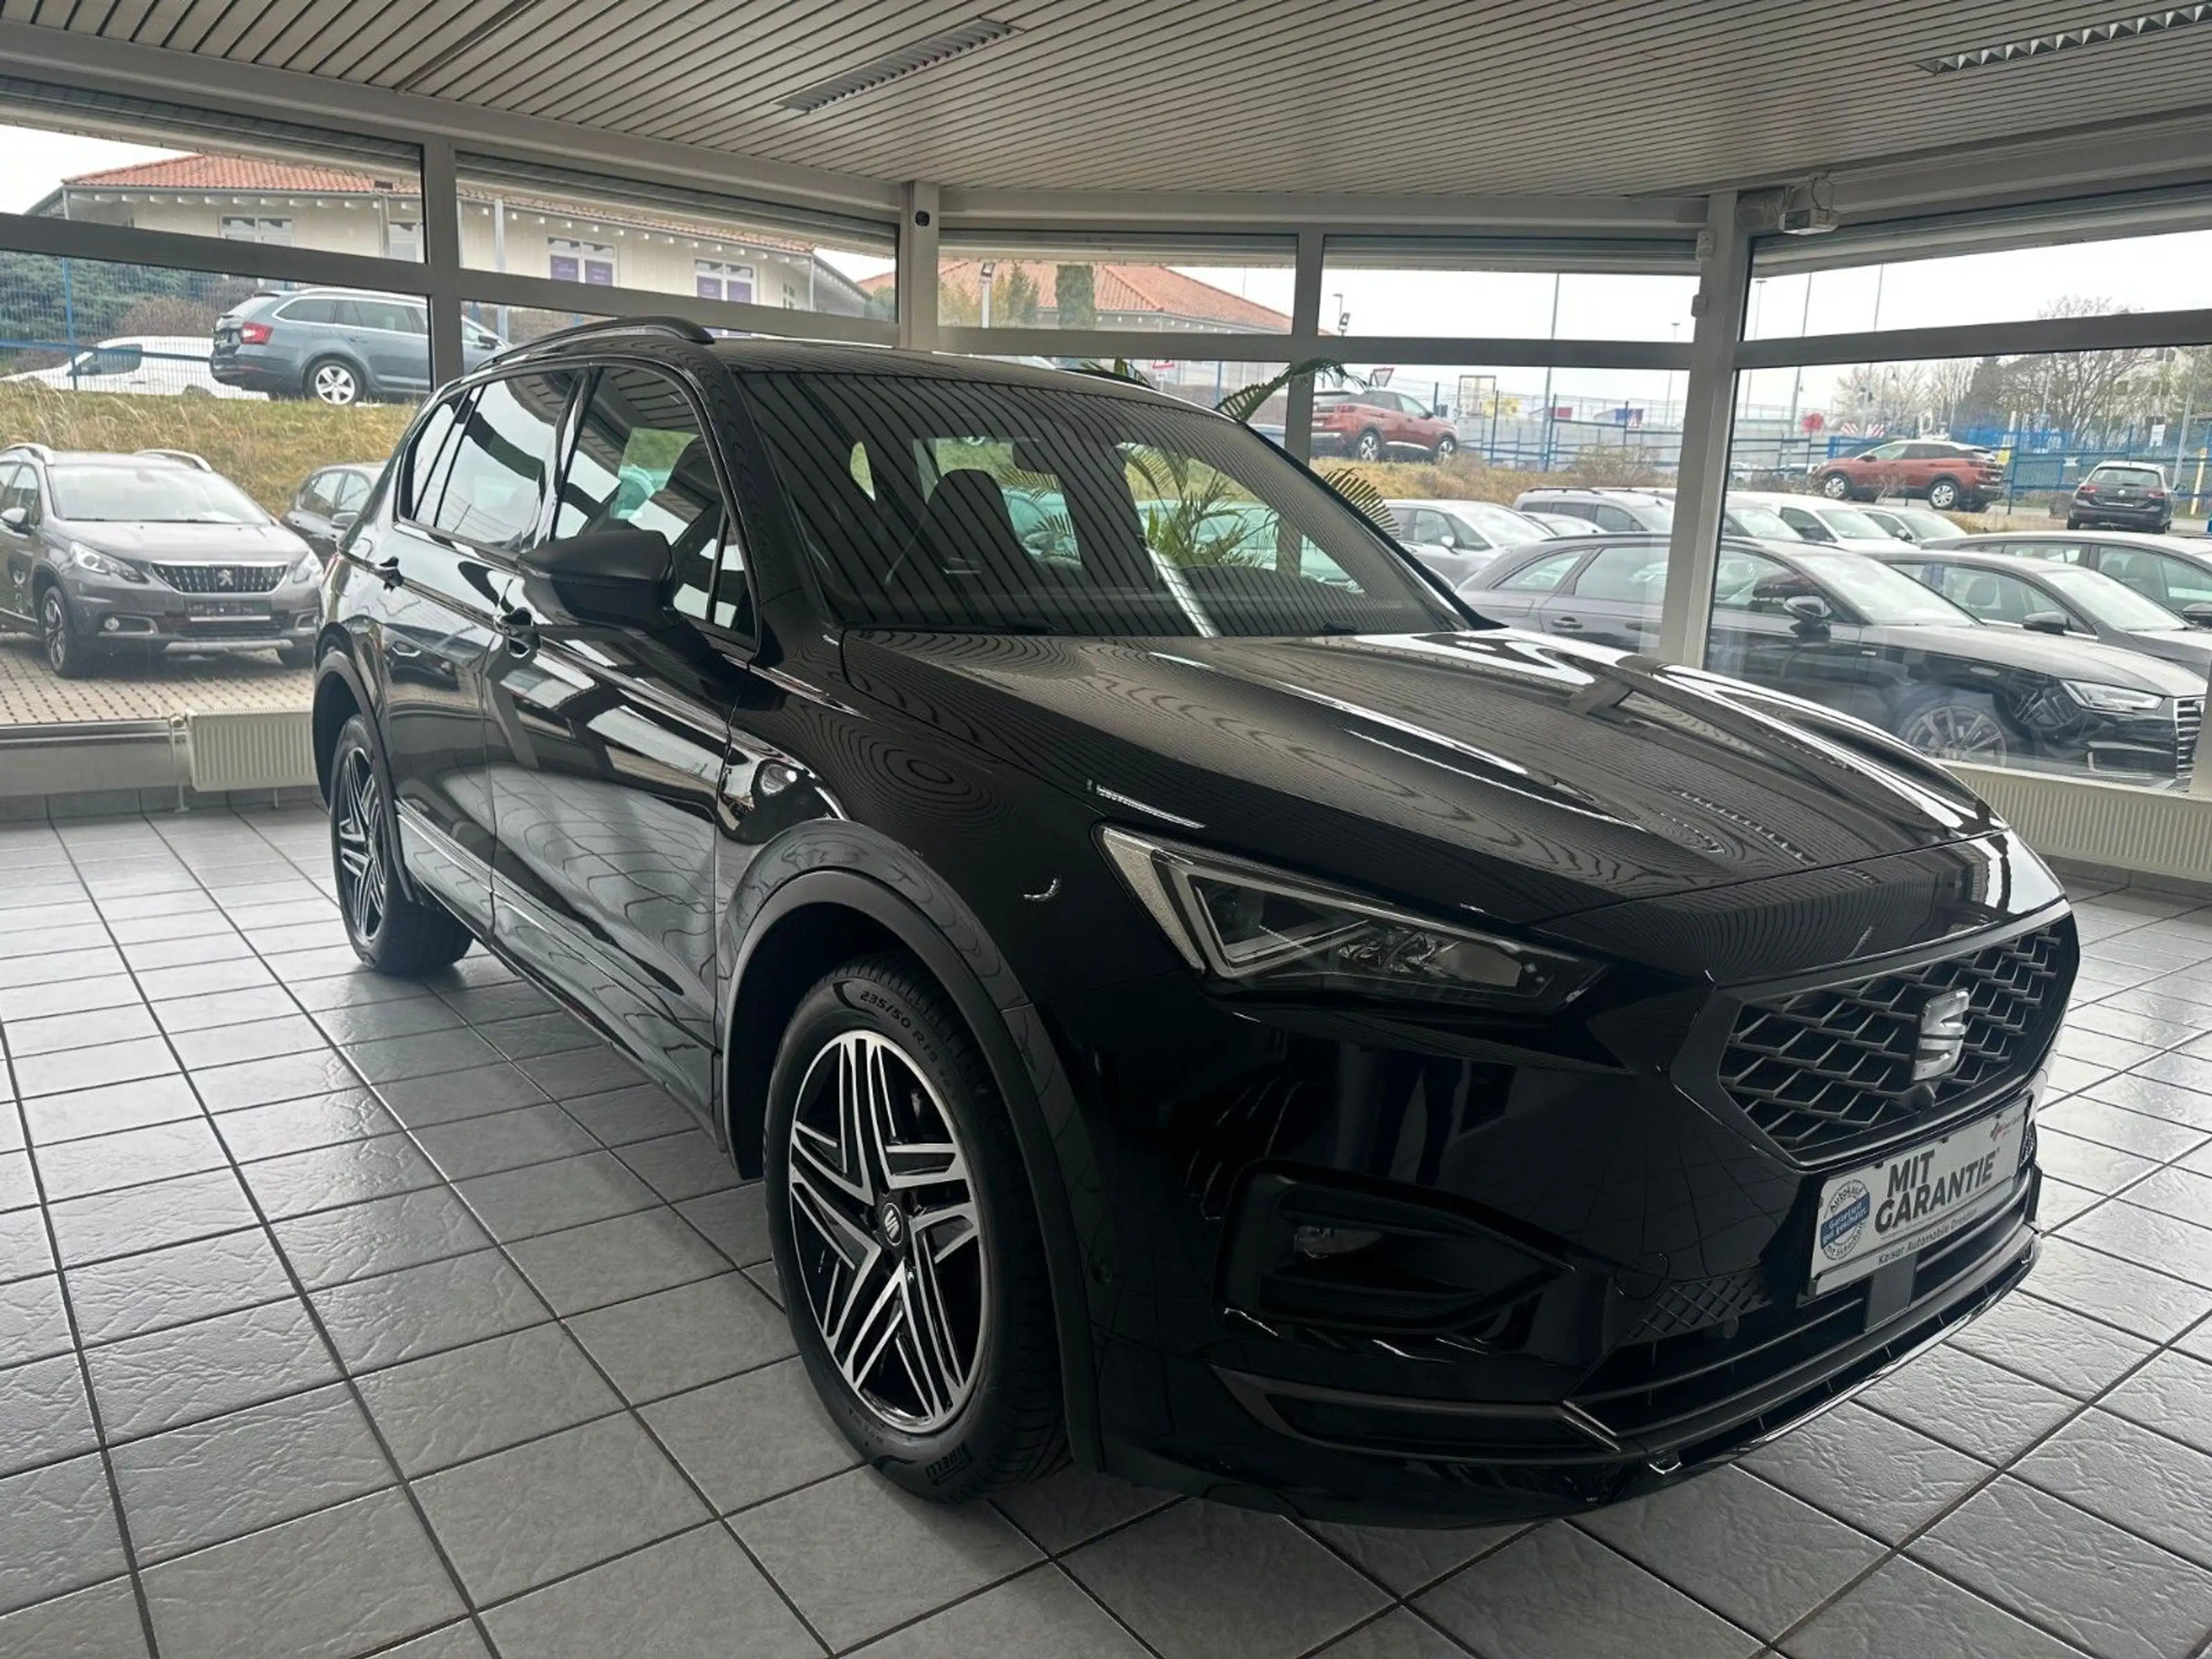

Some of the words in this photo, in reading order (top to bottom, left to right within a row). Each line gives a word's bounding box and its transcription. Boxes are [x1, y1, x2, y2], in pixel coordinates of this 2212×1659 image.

[860, 990, 911, 1028] 235/50
[1874, 1150, 1997, 1233] GARANTIE
[1887, 1149, 1935, 1198] MIT
